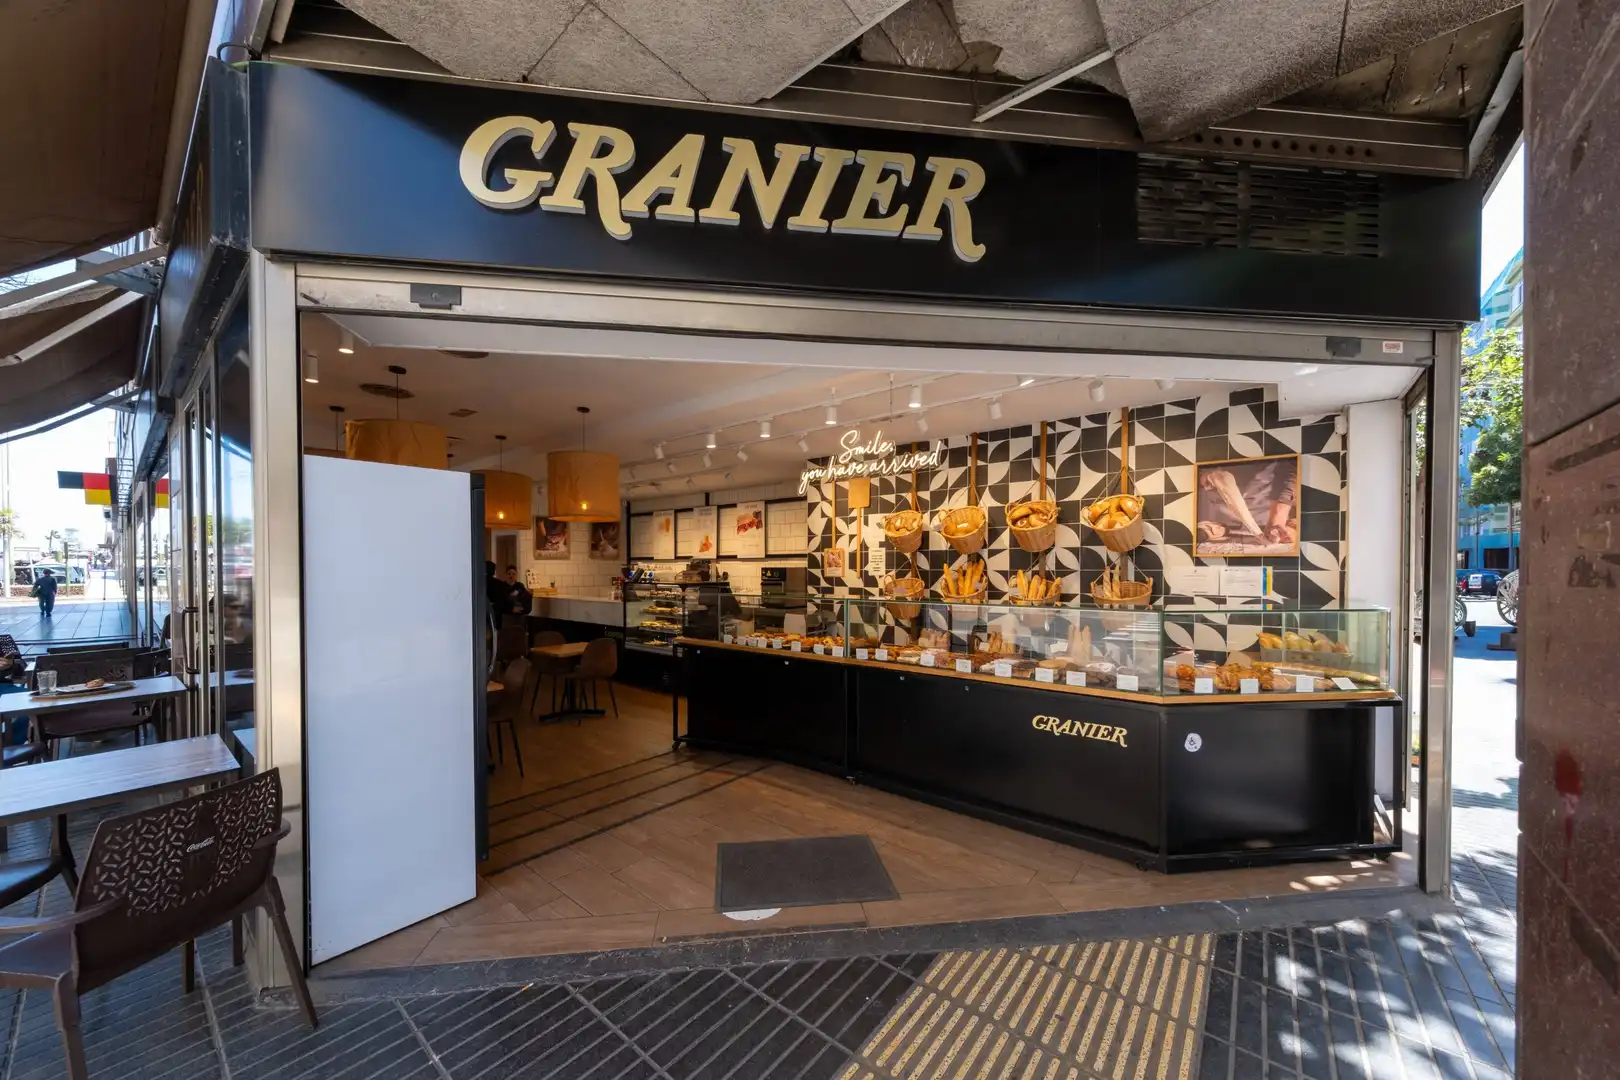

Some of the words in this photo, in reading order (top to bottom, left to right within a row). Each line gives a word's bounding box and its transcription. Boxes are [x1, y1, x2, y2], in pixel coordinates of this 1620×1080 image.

[459, 115, 987, 263] GRANIER
[798, 468, 827, 495] you
[826, 455, 867, 479] have
[869, 440, 942, 474] arrived
[1032, 714, 1128, 748] GRANIER
